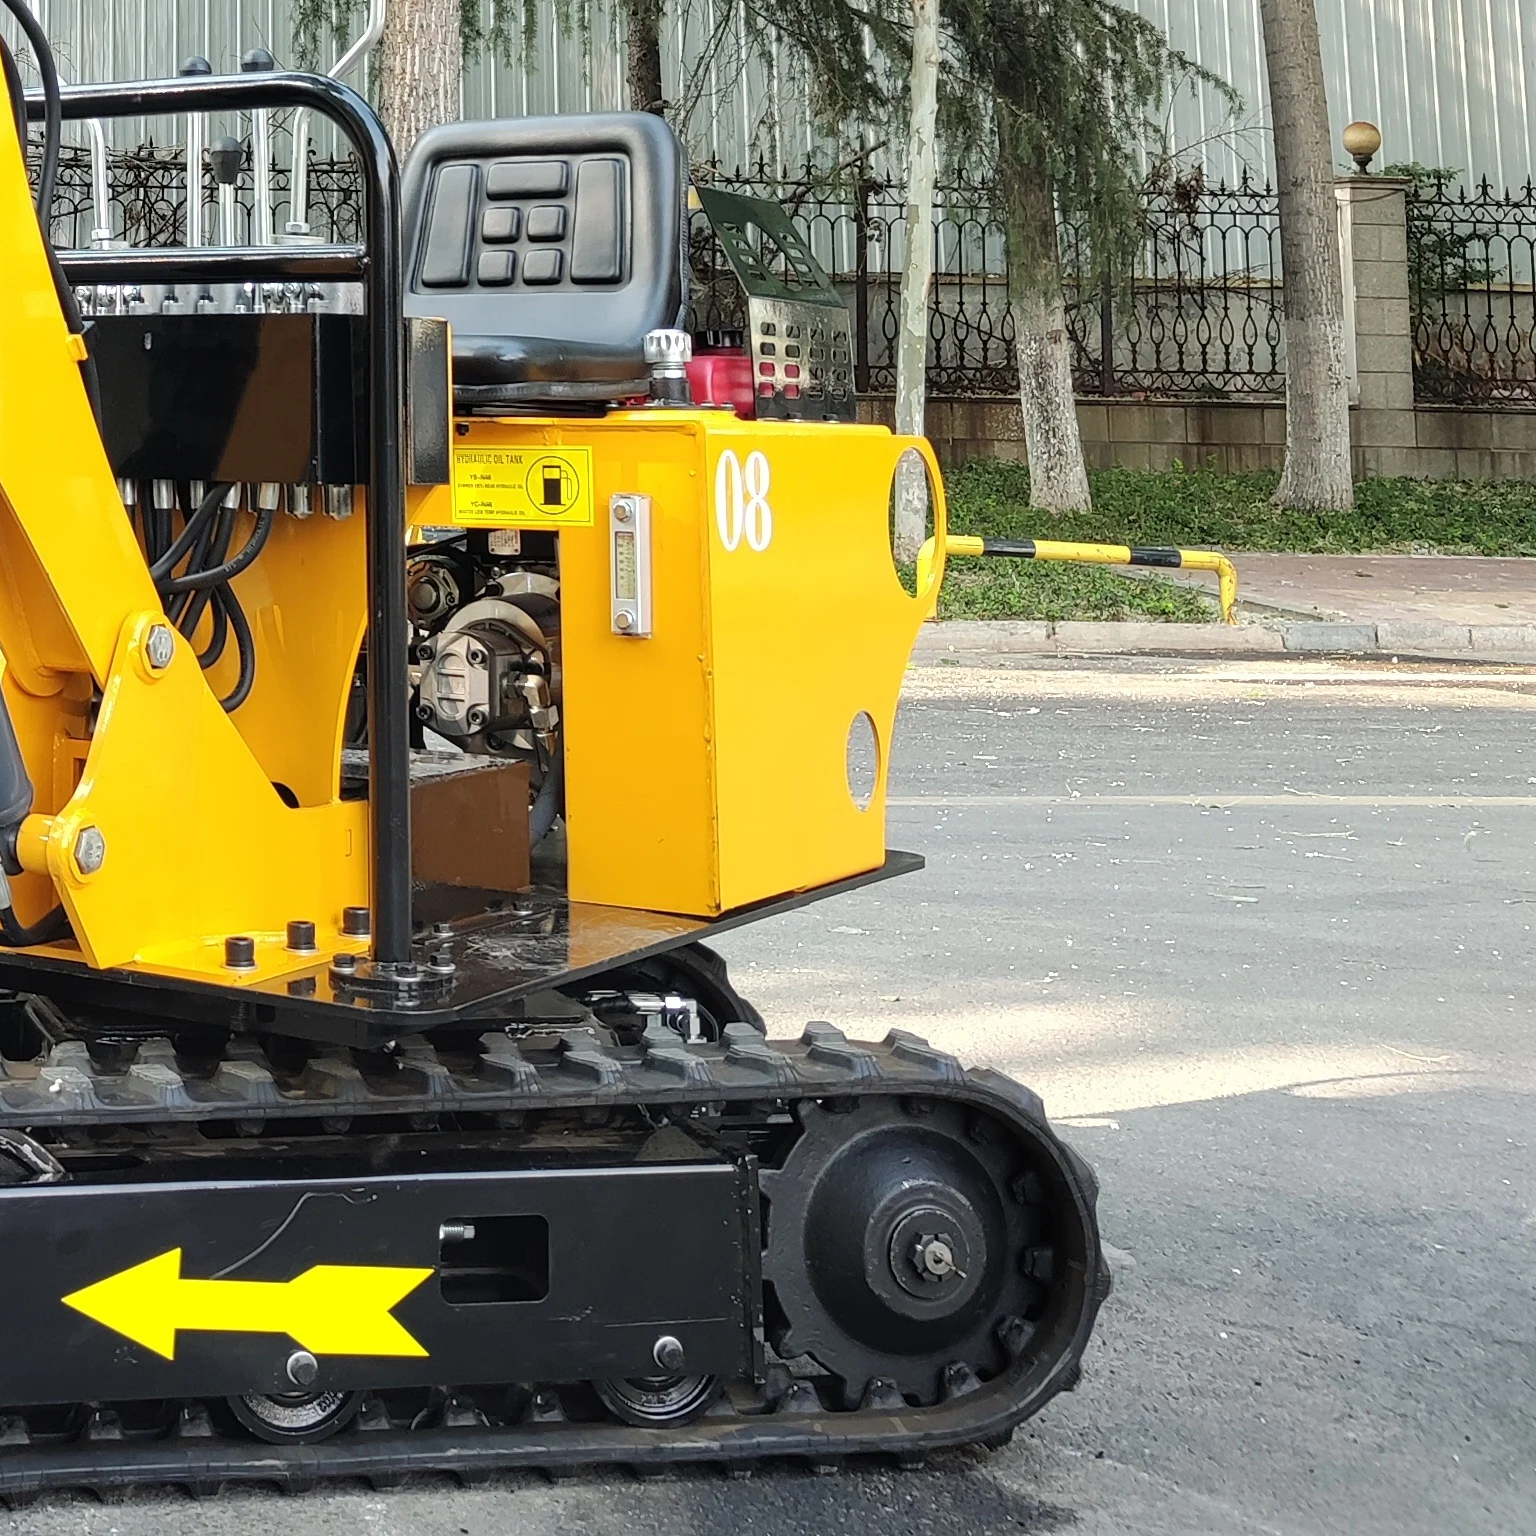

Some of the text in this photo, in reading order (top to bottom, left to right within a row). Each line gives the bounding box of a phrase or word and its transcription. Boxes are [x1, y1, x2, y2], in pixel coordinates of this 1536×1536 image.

[456, 453, 523, 464] HYDRAULIC OIL TANK
[714, 448, 772, 552] 08
